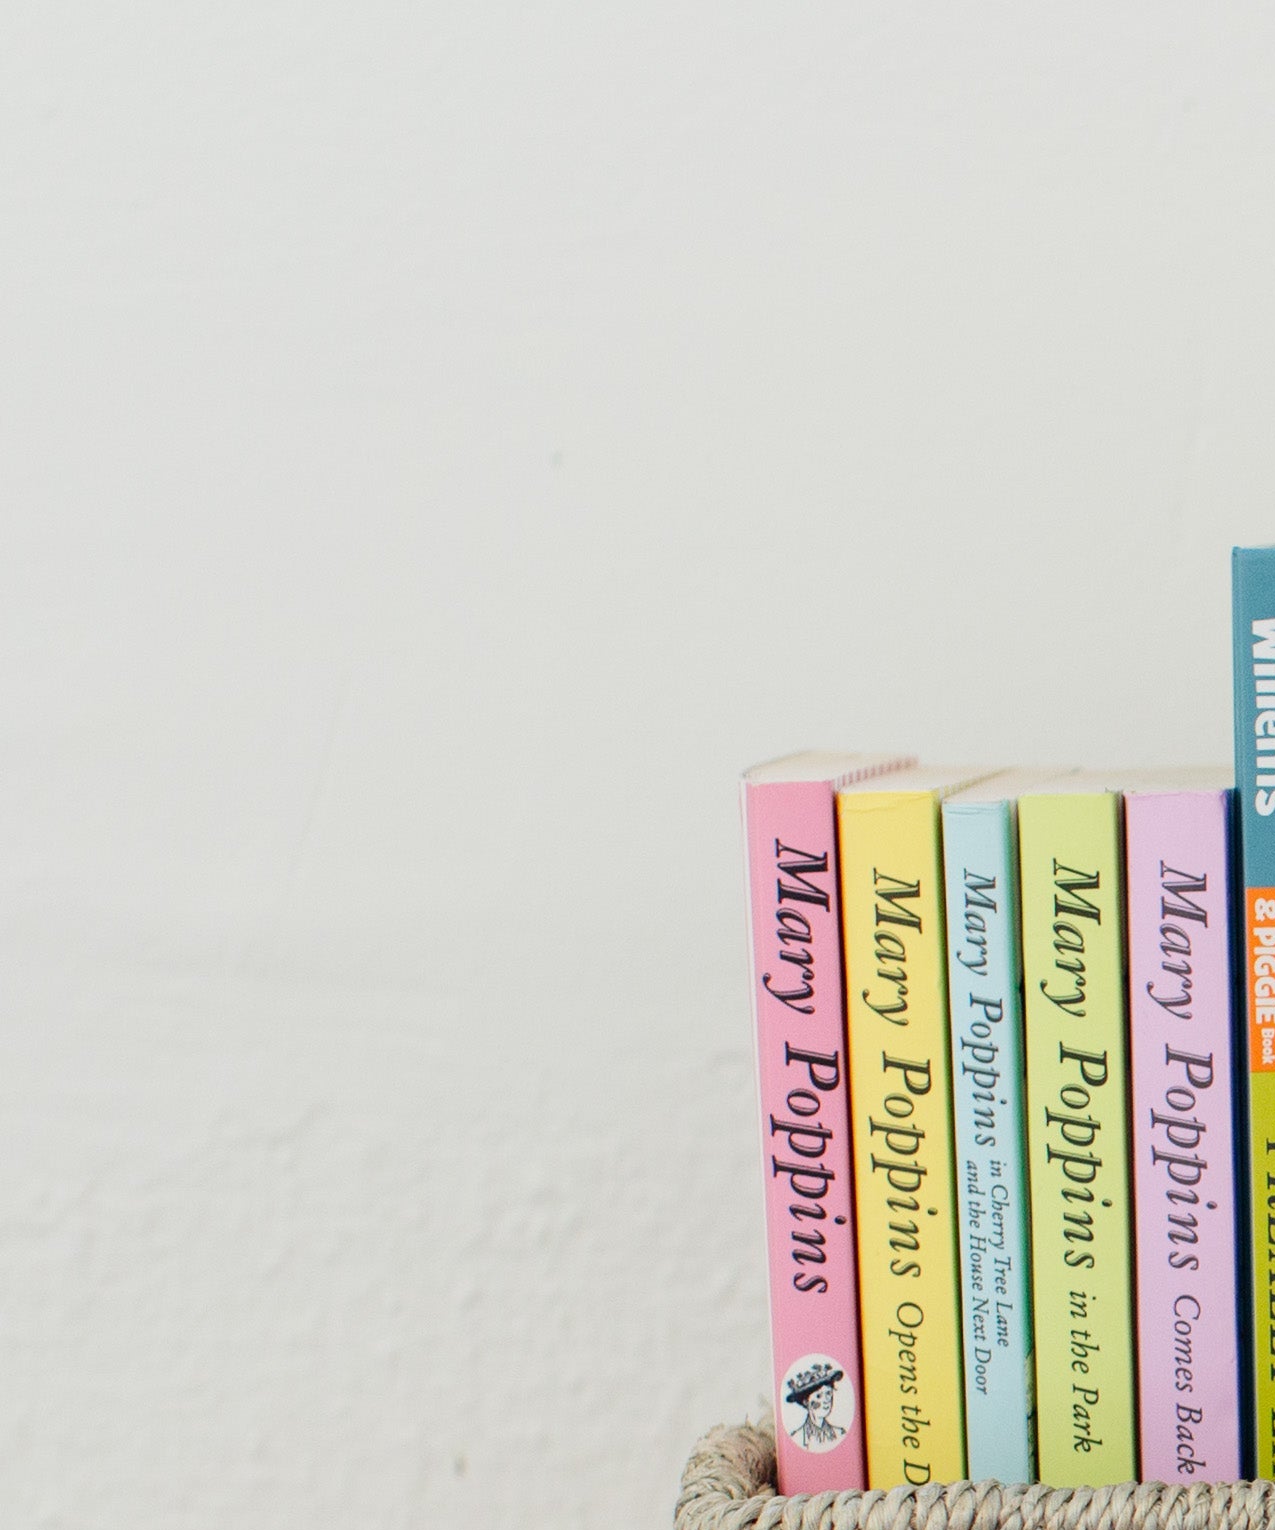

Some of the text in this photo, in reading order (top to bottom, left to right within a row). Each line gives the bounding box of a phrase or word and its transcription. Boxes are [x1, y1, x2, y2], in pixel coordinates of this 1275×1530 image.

[762, 838, 847, 1294] Mary Poppins
[861, 867, 938, 1487] Mary Poppins Opens the D
[956, 868, 1007, 1147] Mary Poppins
[1039, 858, 1113, 1453] Mary Poppins in the Park
[1146, 860, 1218, 1475] Mary Poppins Comes Back
[966, 1159, 992, 1396] and the House Next Door
[987, 1159, 1014, 1348] in Cherry Tree Lane
